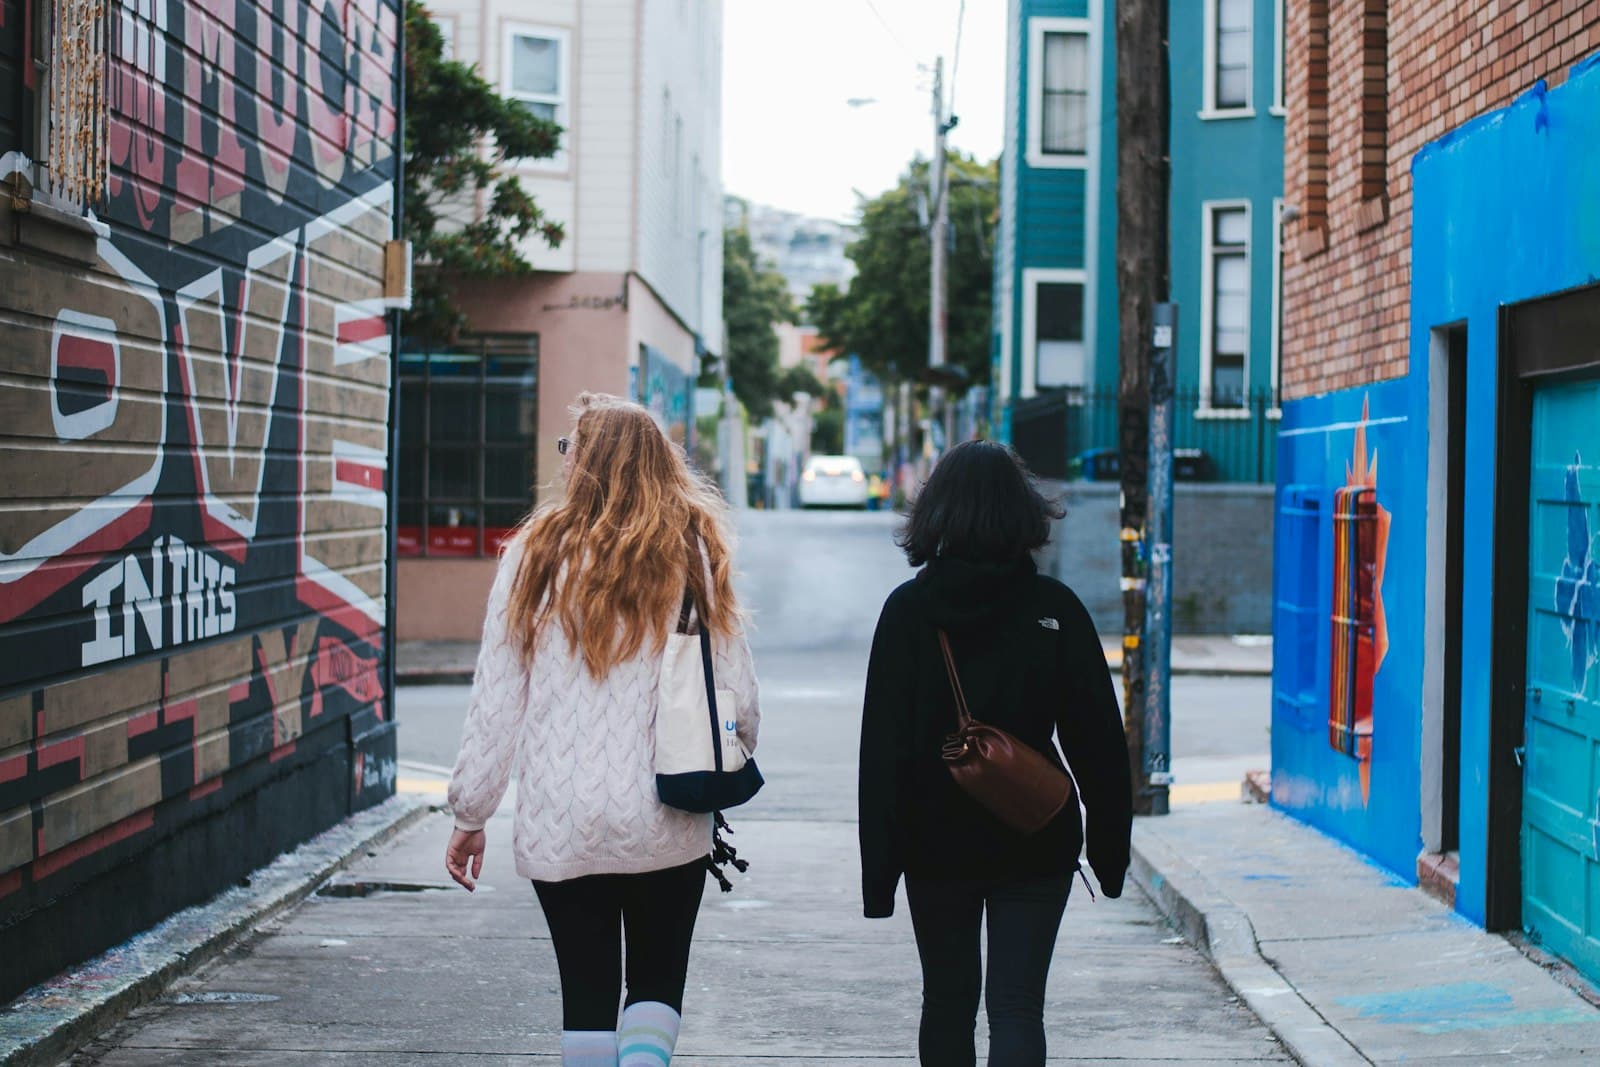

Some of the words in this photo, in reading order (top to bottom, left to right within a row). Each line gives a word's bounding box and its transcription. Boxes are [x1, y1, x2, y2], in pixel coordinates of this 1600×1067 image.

[82, 534, 164, 667] IN
[168, 534, 237, 646] THIS
[0, 616, 320, 895] ITY
